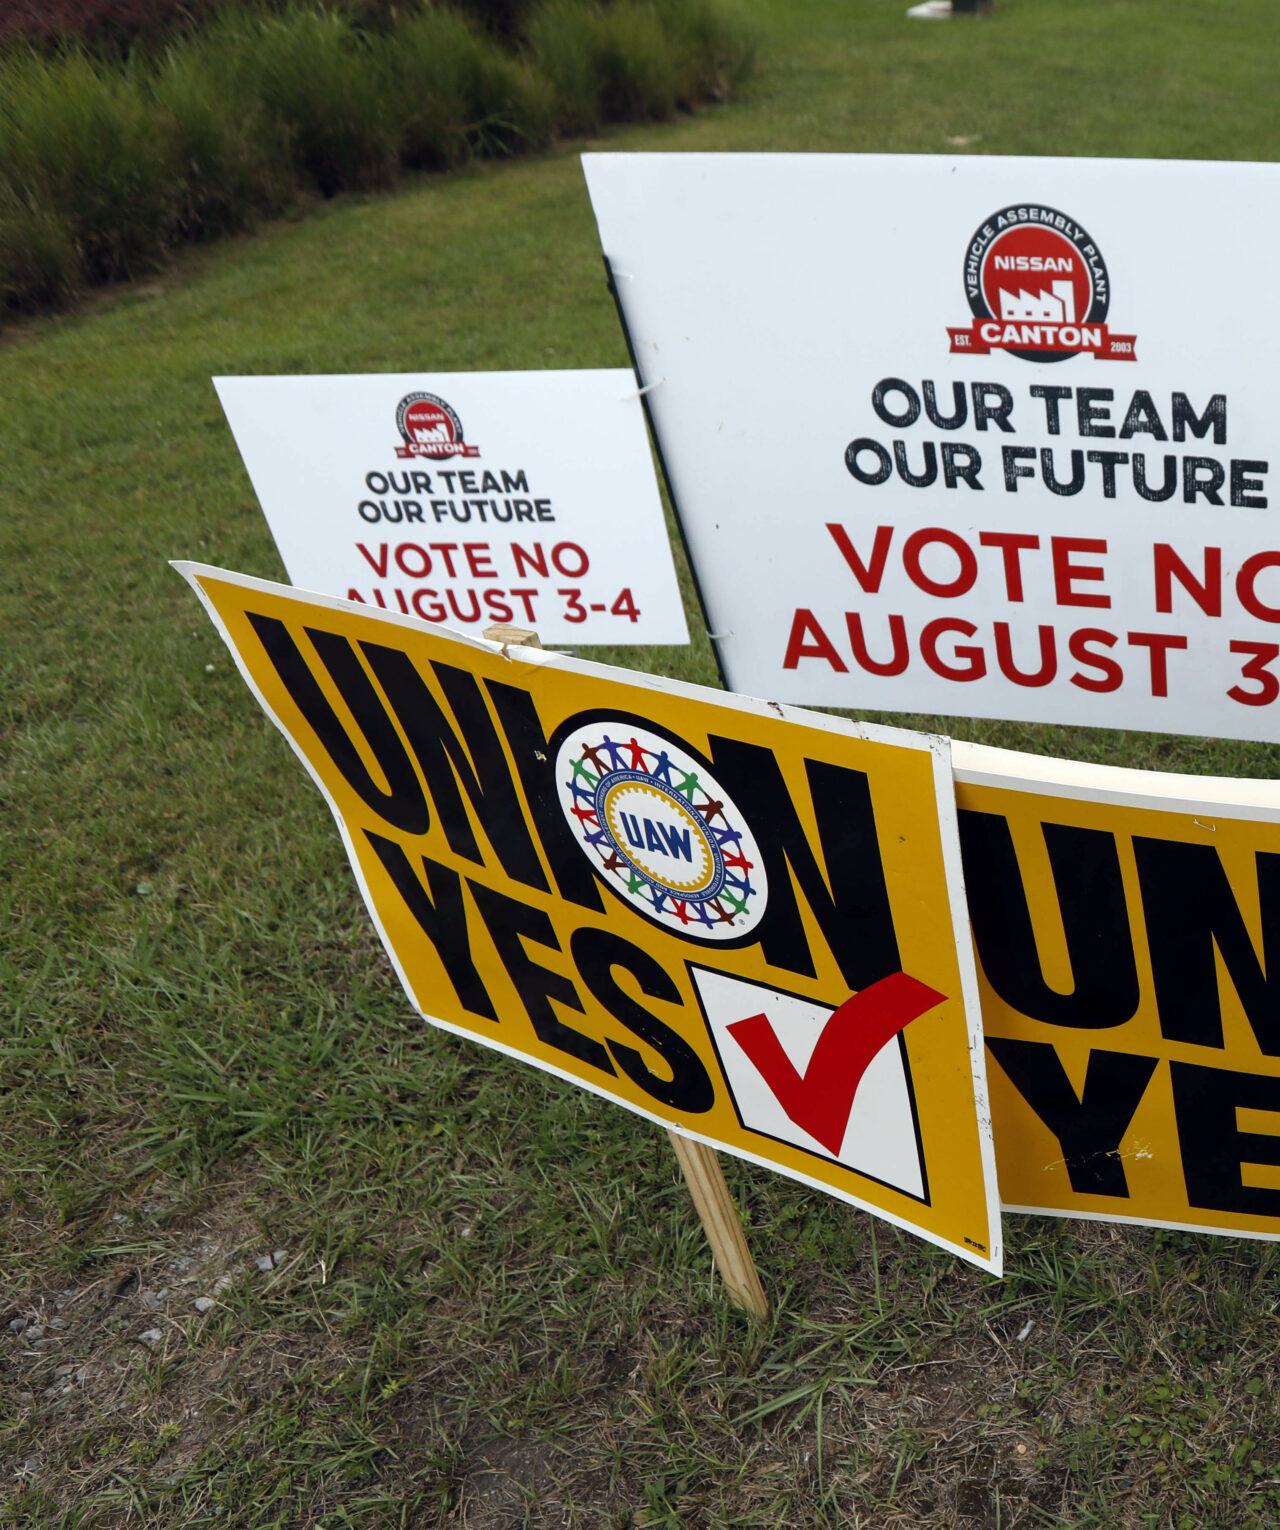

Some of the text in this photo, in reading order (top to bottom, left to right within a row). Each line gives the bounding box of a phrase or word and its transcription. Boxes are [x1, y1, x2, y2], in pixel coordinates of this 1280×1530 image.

[967, 208, 1107, 304] VEHICLE ASSEMBLY PLANT
[994, 255, 1073, 272] NISSAN
[954, 323, 1132, 353] EST. CANTON 2003
[408, 413, 445, 421] NISSAN
[872, 377, 1227, 445] OUR TEAM
[408, 443, 465, 454] CANTON
[365, 469, 529, 494] OUR TEAM
[845, 437, 1269, 509] OUR FUTURE
[358, 499, 556, 524] OUR FUTURE
[356, 541, 590, 579] VOTE NO
[825, 522, 1111, 609] VOTE
[558, 588, 641, 624] 3-4
[783, 608, 1187, 697] AUGUST
[245, 610, 903, 992] UNION
[619, 811, 692, 863] UAW
[361, 829, 715, 1113] YES
